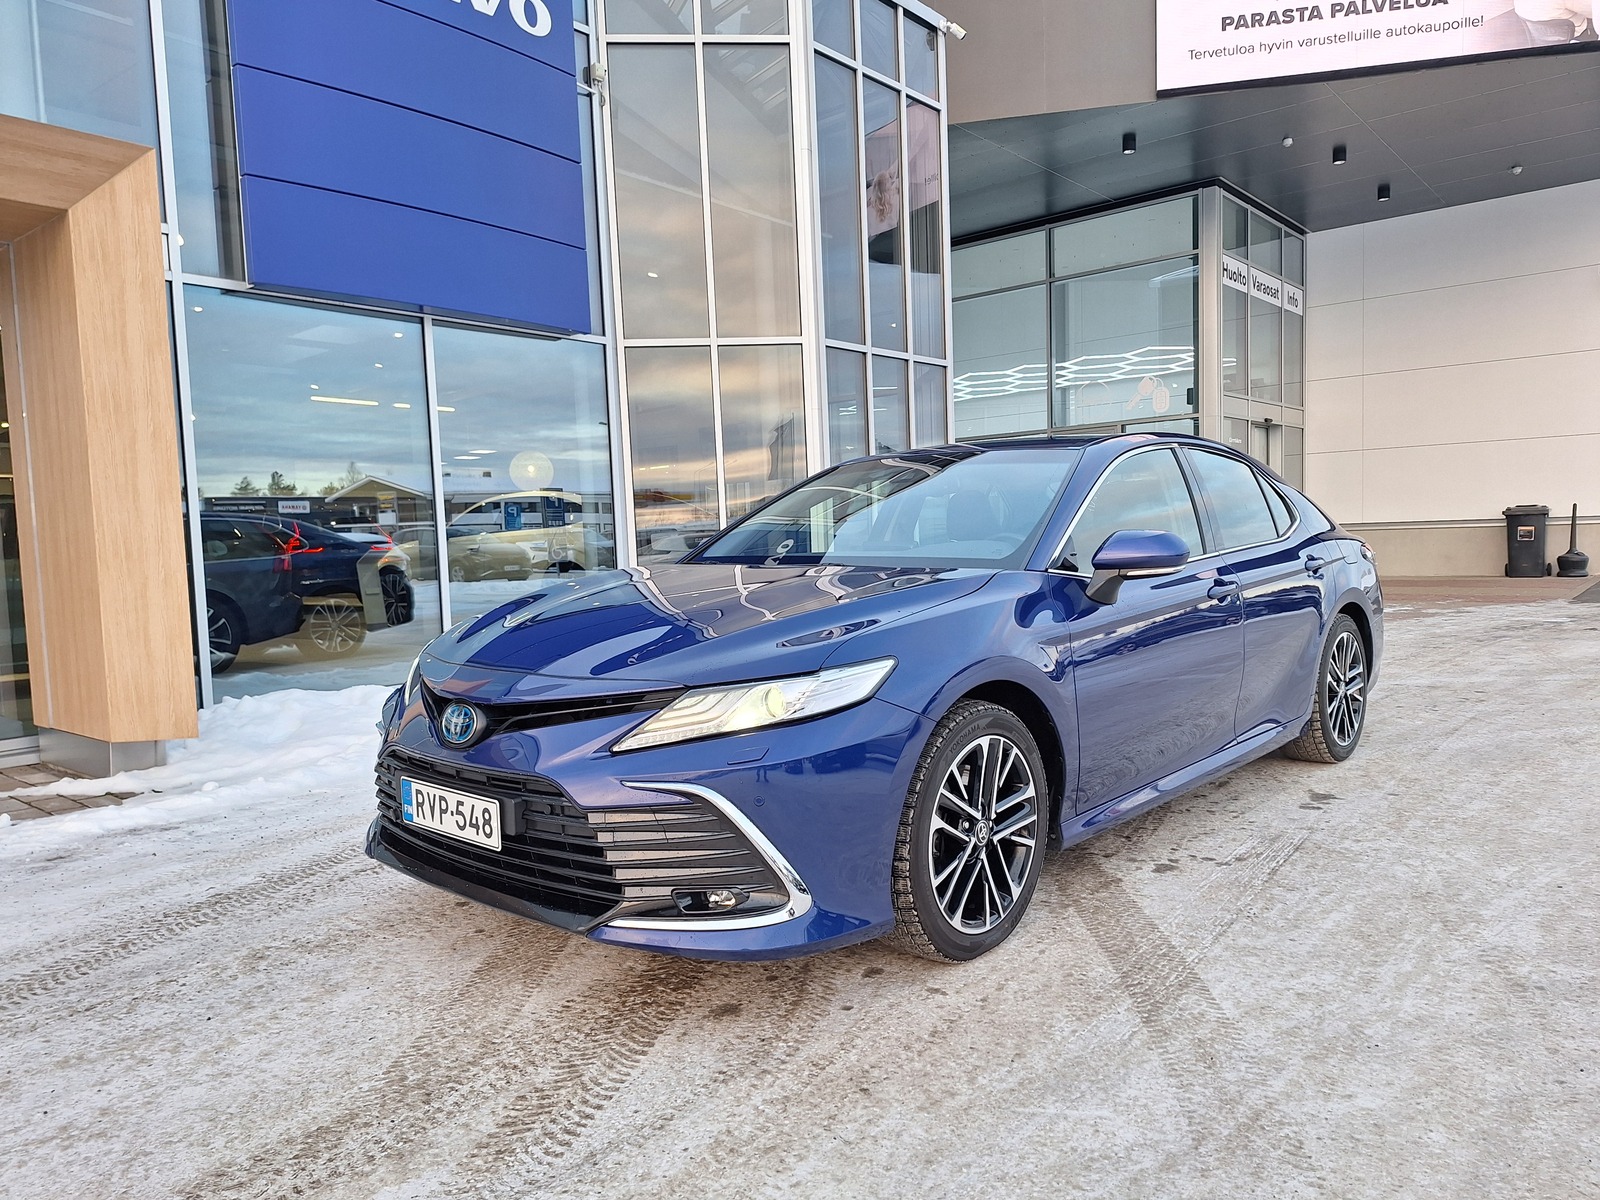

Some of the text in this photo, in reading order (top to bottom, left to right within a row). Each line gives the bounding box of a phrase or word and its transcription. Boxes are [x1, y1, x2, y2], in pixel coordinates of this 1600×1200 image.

[1188, 15, 1484, 60] Tervetuloa hyvin varustelluille autokaupoille!
[1221, 5, 1324, 32] PARASTA
[1222, 261, 1299, 308] Huolto Varaosat Info
[950, 723, 980, 754] YOKOHAMA
[415, 788, 493, 839] RVP-548
